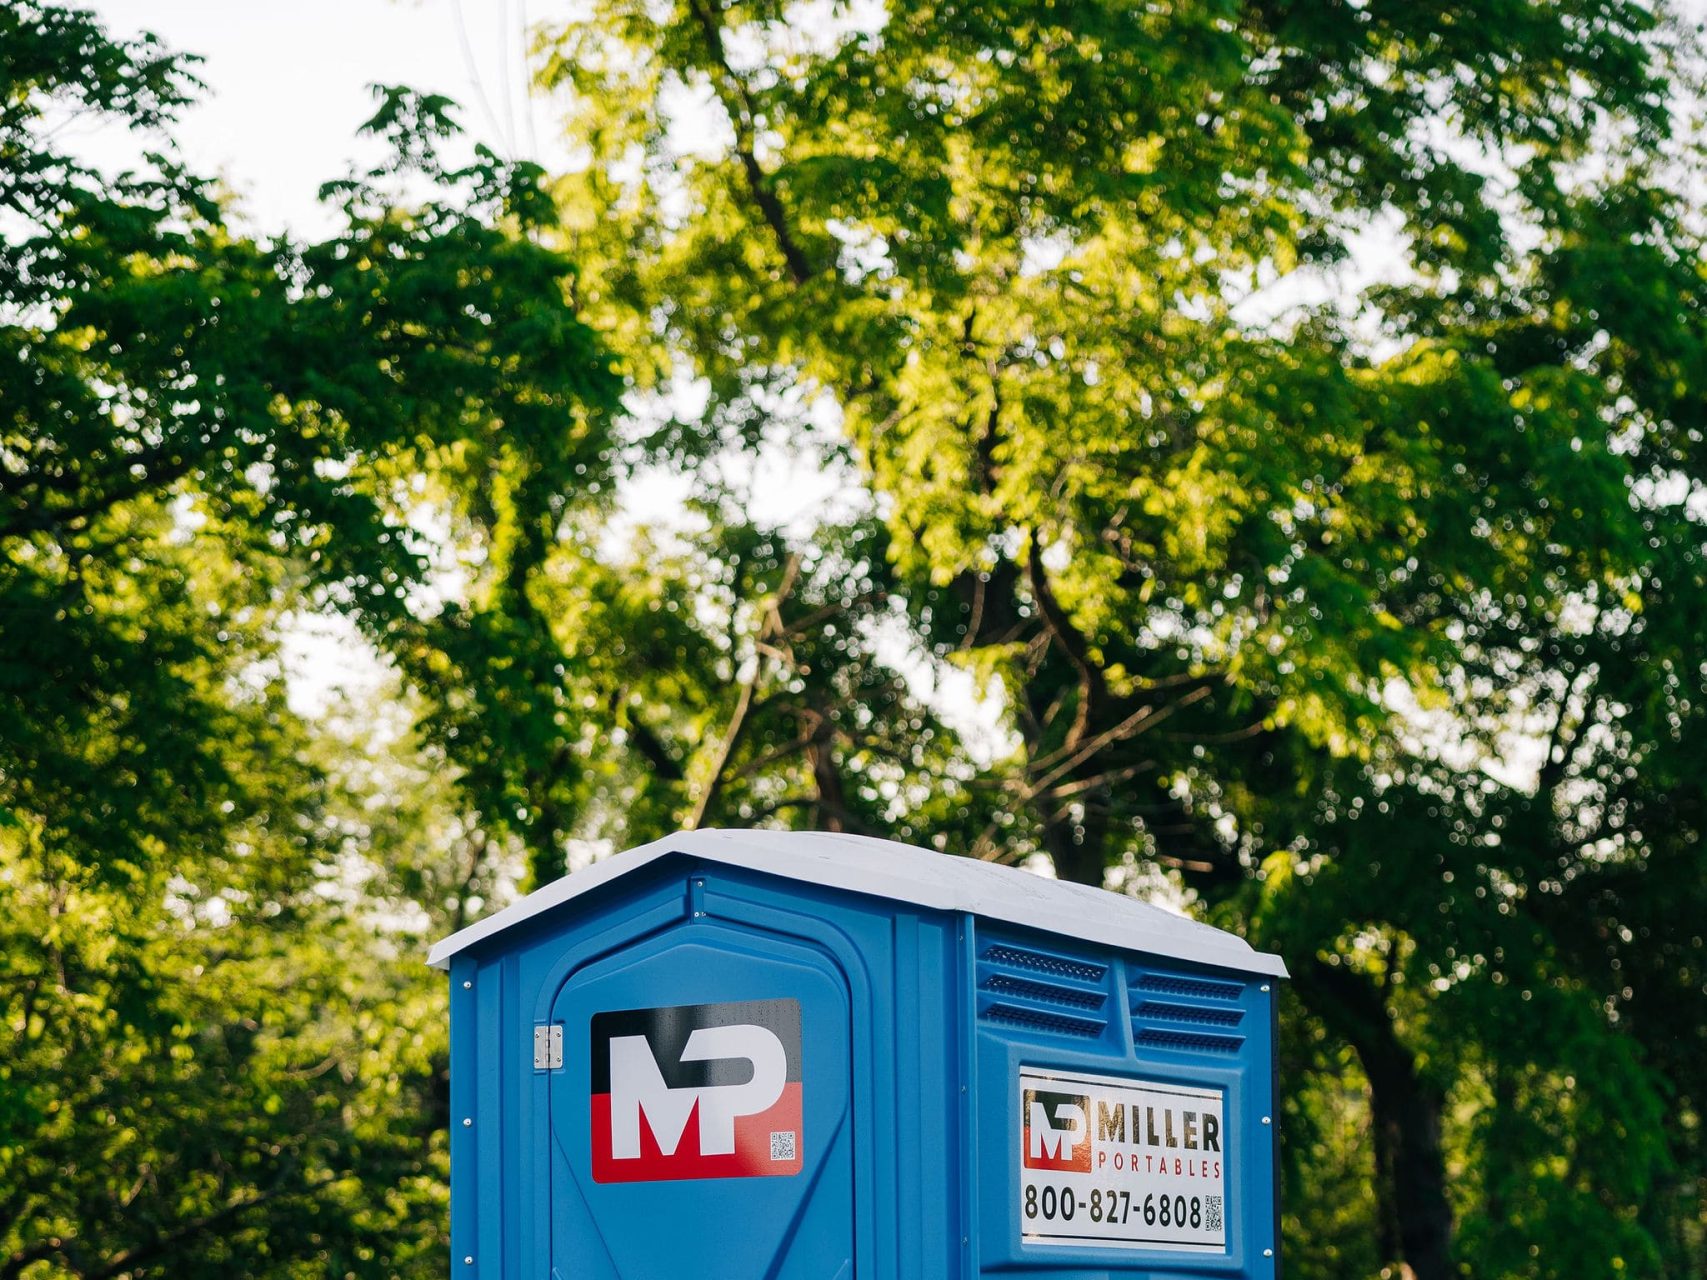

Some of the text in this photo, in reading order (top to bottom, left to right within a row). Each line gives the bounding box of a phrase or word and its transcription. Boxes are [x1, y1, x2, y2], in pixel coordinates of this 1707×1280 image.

[609, 1024, 787, 1160] MP
[1030, 1101, 1086, 1161] MP
[1097, 1101, 1220, 1152] MILLER
[1098, 1151, 1220, 1179] PORTABLES
[1025, 1184, 1201, 1229] 800-827-6808
